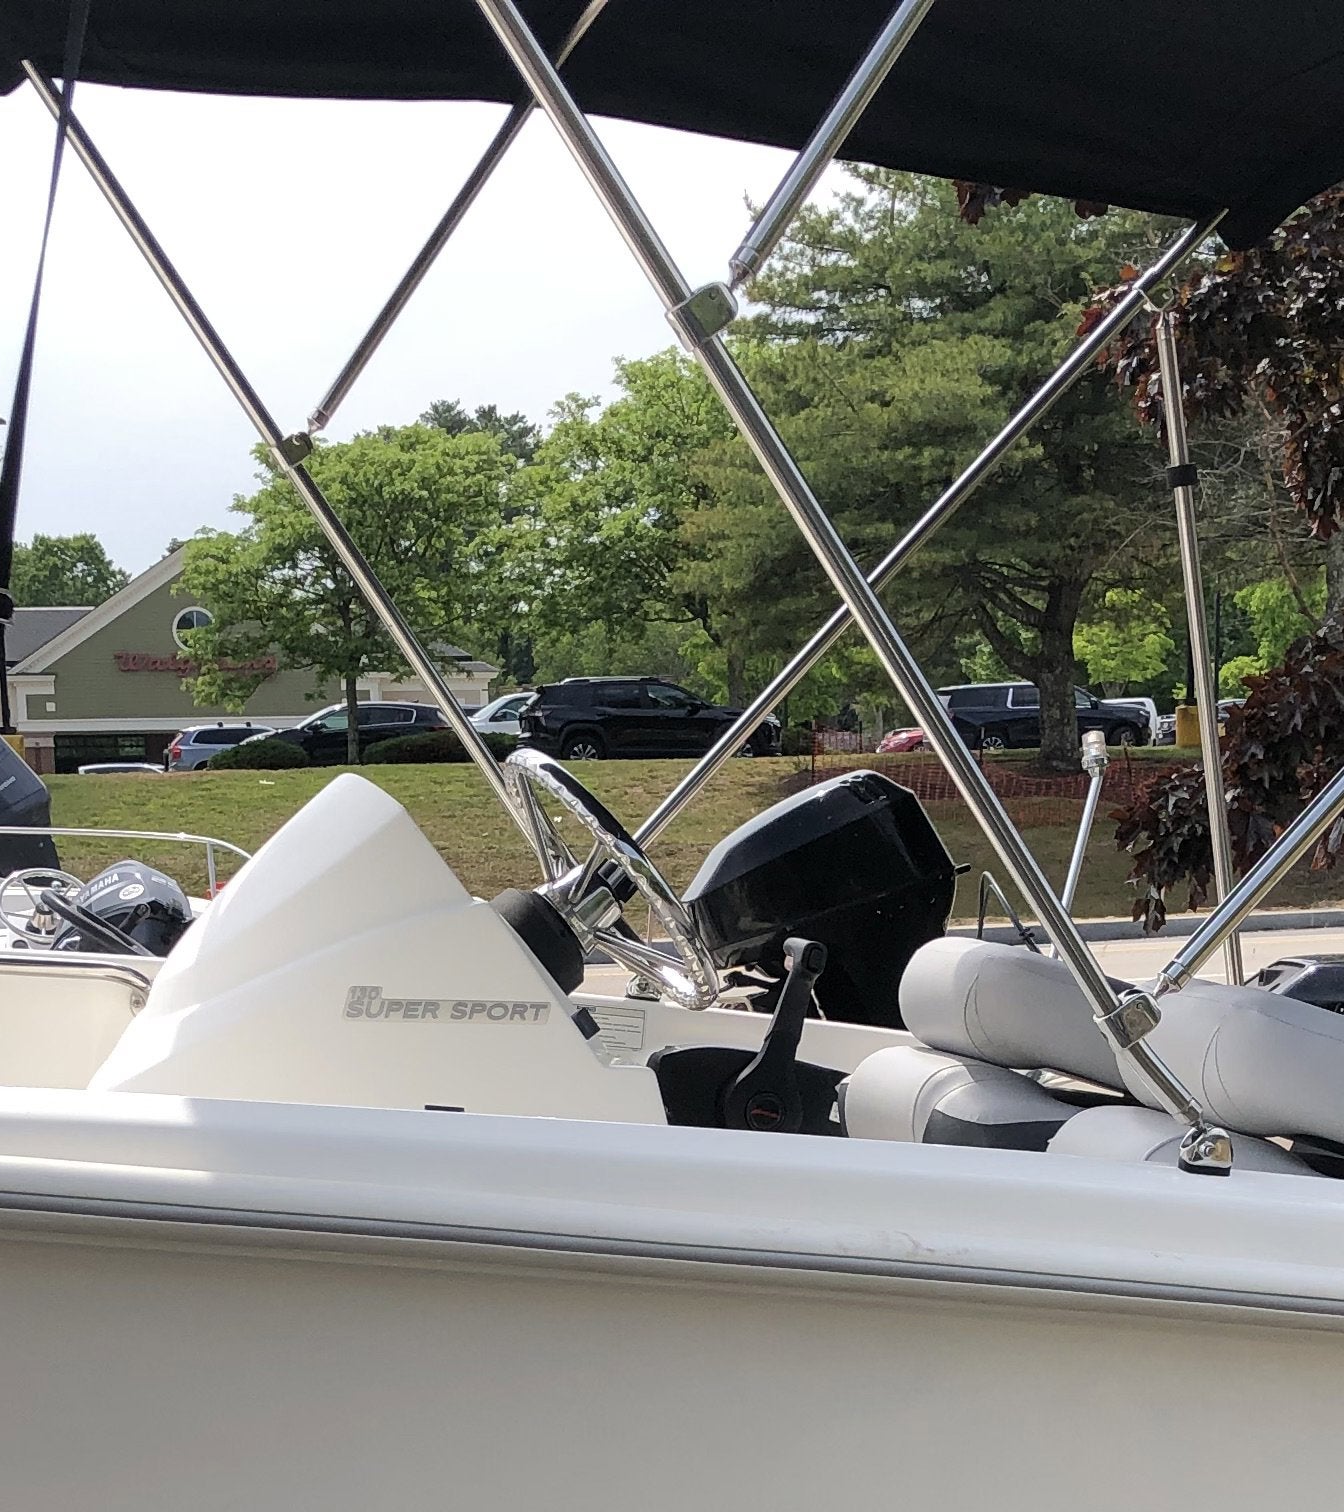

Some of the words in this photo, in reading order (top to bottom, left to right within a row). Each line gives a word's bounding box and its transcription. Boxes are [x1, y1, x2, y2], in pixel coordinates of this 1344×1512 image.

[79, 873, 119, 903] YAMAHA
[346, 1000, 440, 1020] SUPER
[450, 1001, 549, 1022] SPORT
